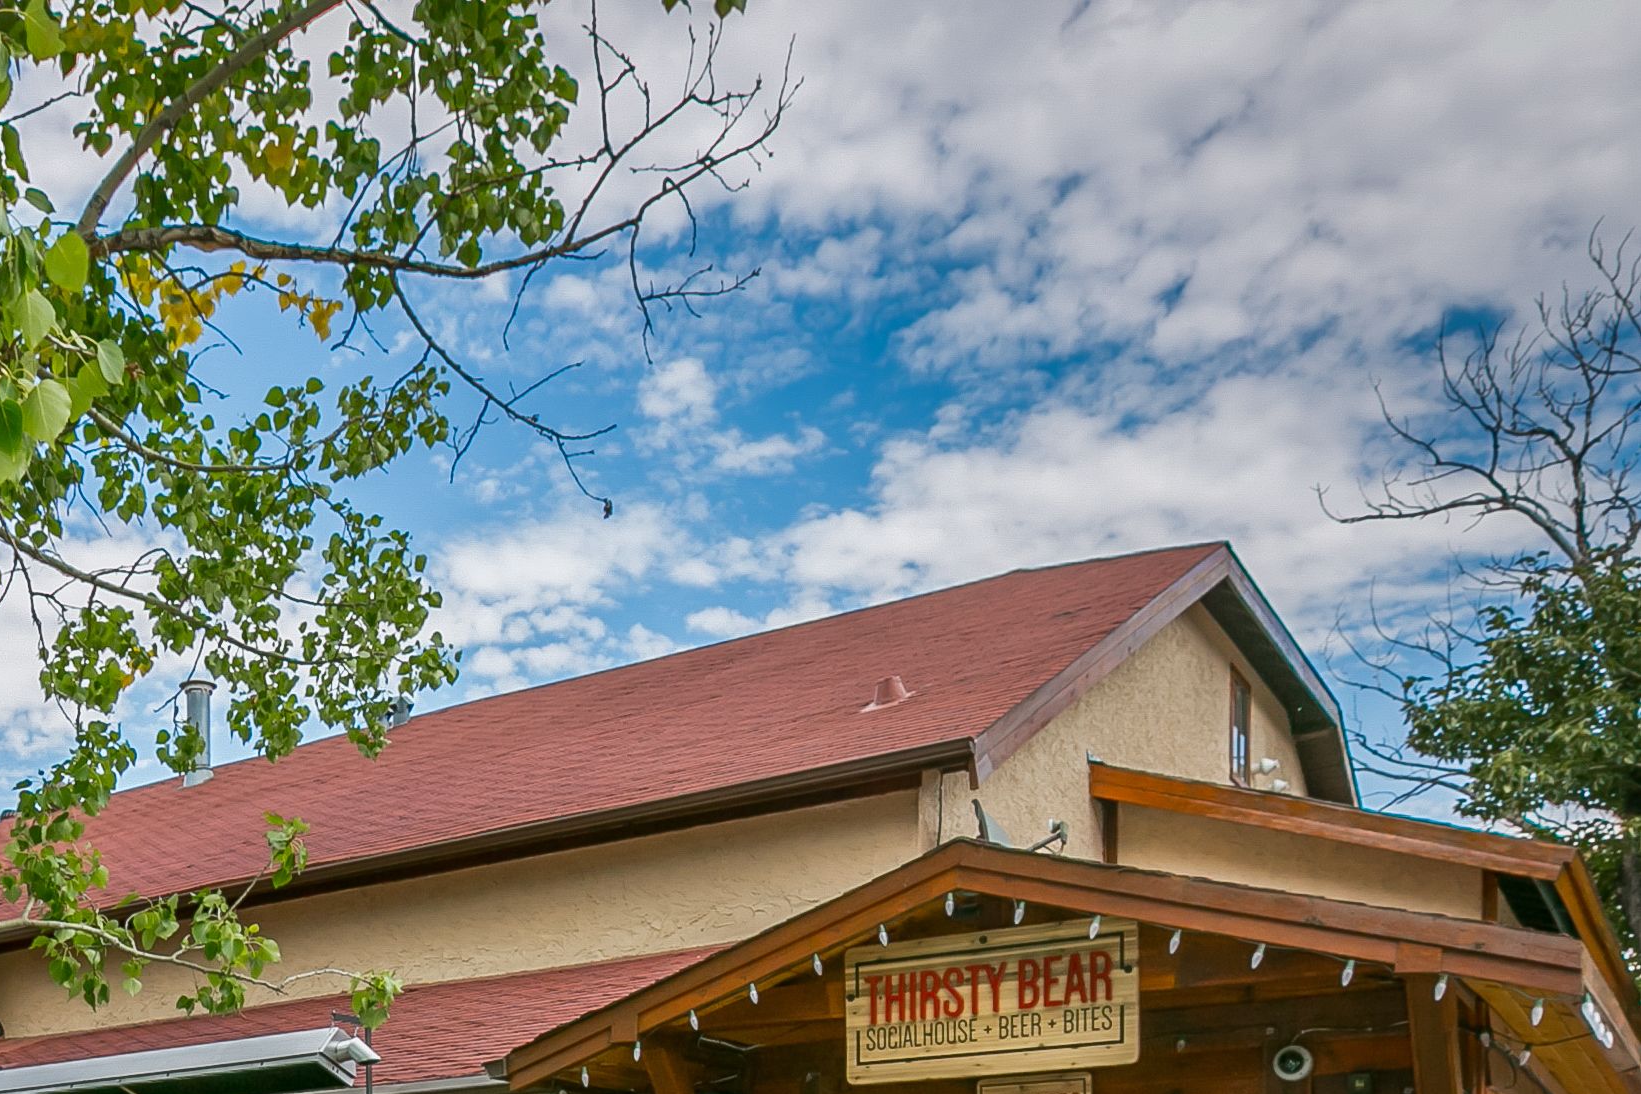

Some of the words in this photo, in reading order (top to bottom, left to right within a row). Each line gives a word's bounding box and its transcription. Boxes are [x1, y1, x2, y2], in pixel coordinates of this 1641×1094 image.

[864, 961, 1007, 1026] THIRSTY
[1018, 950, 1113, 1009] BEAR
[866, 1018, 978, 1052] SOCIALHOUSE
[998, 1012, 1042, 1040] BEER
[1063, 1005, 1113, 1033] BITES
